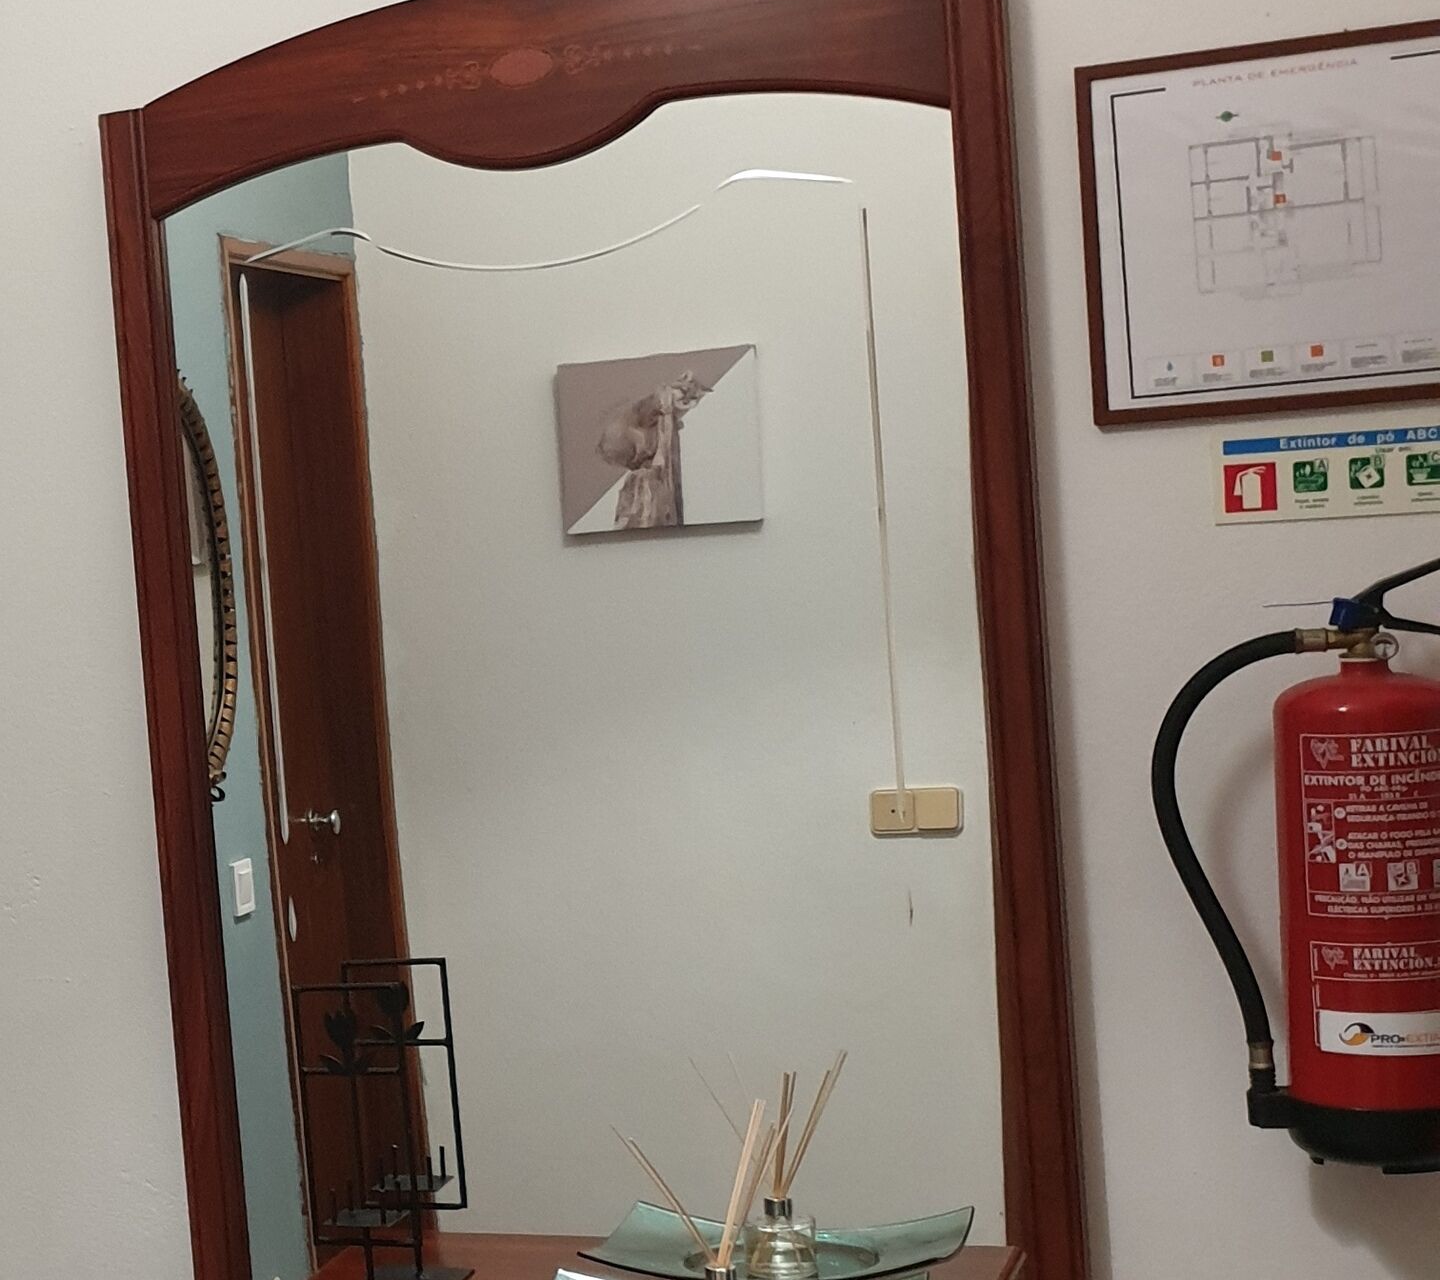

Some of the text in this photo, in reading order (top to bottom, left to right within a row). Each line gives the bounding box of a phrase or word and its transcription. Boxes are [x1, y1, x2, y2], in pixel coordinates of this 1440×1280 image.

[1192, 75, 1242, 87] PLANTA
[1279, 428, 1438, 449] Extintor de pó ABC
[1350, 735, 1431, 752] FARIVAL
[1304, 775, 1365, 786] EXTINTOR
[1369, 774, 1387, 785] DE
[1357, 863, 1369, 876] A
[1353, 947, 1418, 959] FARIVAL
